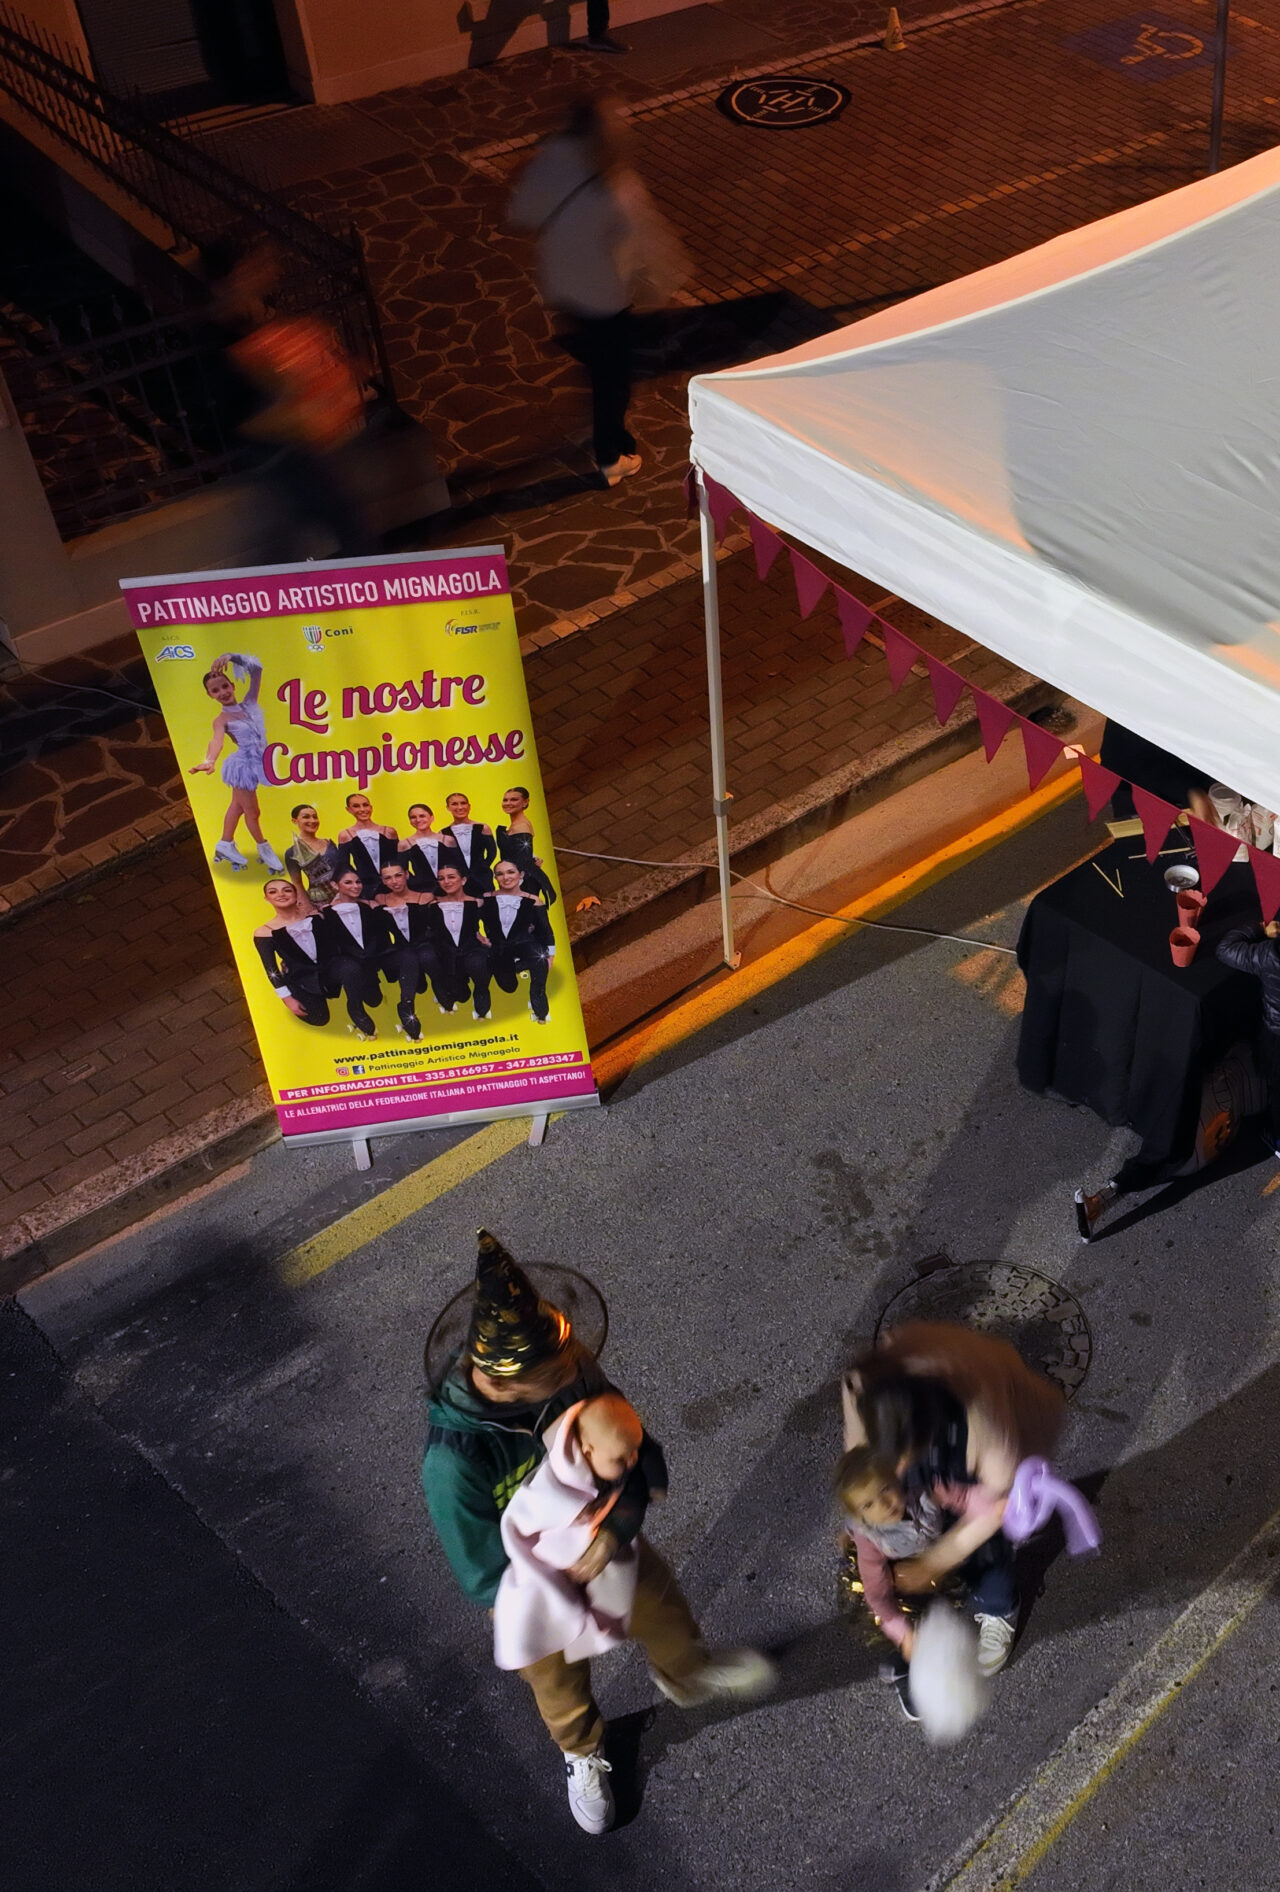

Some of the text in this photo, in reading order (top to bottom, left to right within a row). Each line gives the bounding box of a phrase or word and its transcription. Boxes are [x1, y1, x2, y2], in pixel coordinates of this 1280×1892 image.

[137, 569, 502, 623] PATTINAGGIO ARTISTICO MIGNAGOLA
[325, 625, 354, 637] Coni
[277, 669, 486, 734] Le nostre
[262, 729, 525, 791] Campionesse
[334, 1033, 519, 1064] www.pattinaggiomignagola.it
[369, 1046, 521, 1072] Pattinaggio Artistico Mignagola
[284, 1071, 585, 1118] LE ALLENATRICI DELLA FEDERAZIONE ITALIANA DI PATTINAGGIO TI ASPETTANO!
[287, 1089, 309, 1099] PER
[311, 1077, 398, 1096] INFORMAZIONI
[400, 1075, 422, 1084] TEL.
[425, 1064, 495, 1081] 335.8166957
[506, 1053, 575, 1069] 347.8283347
